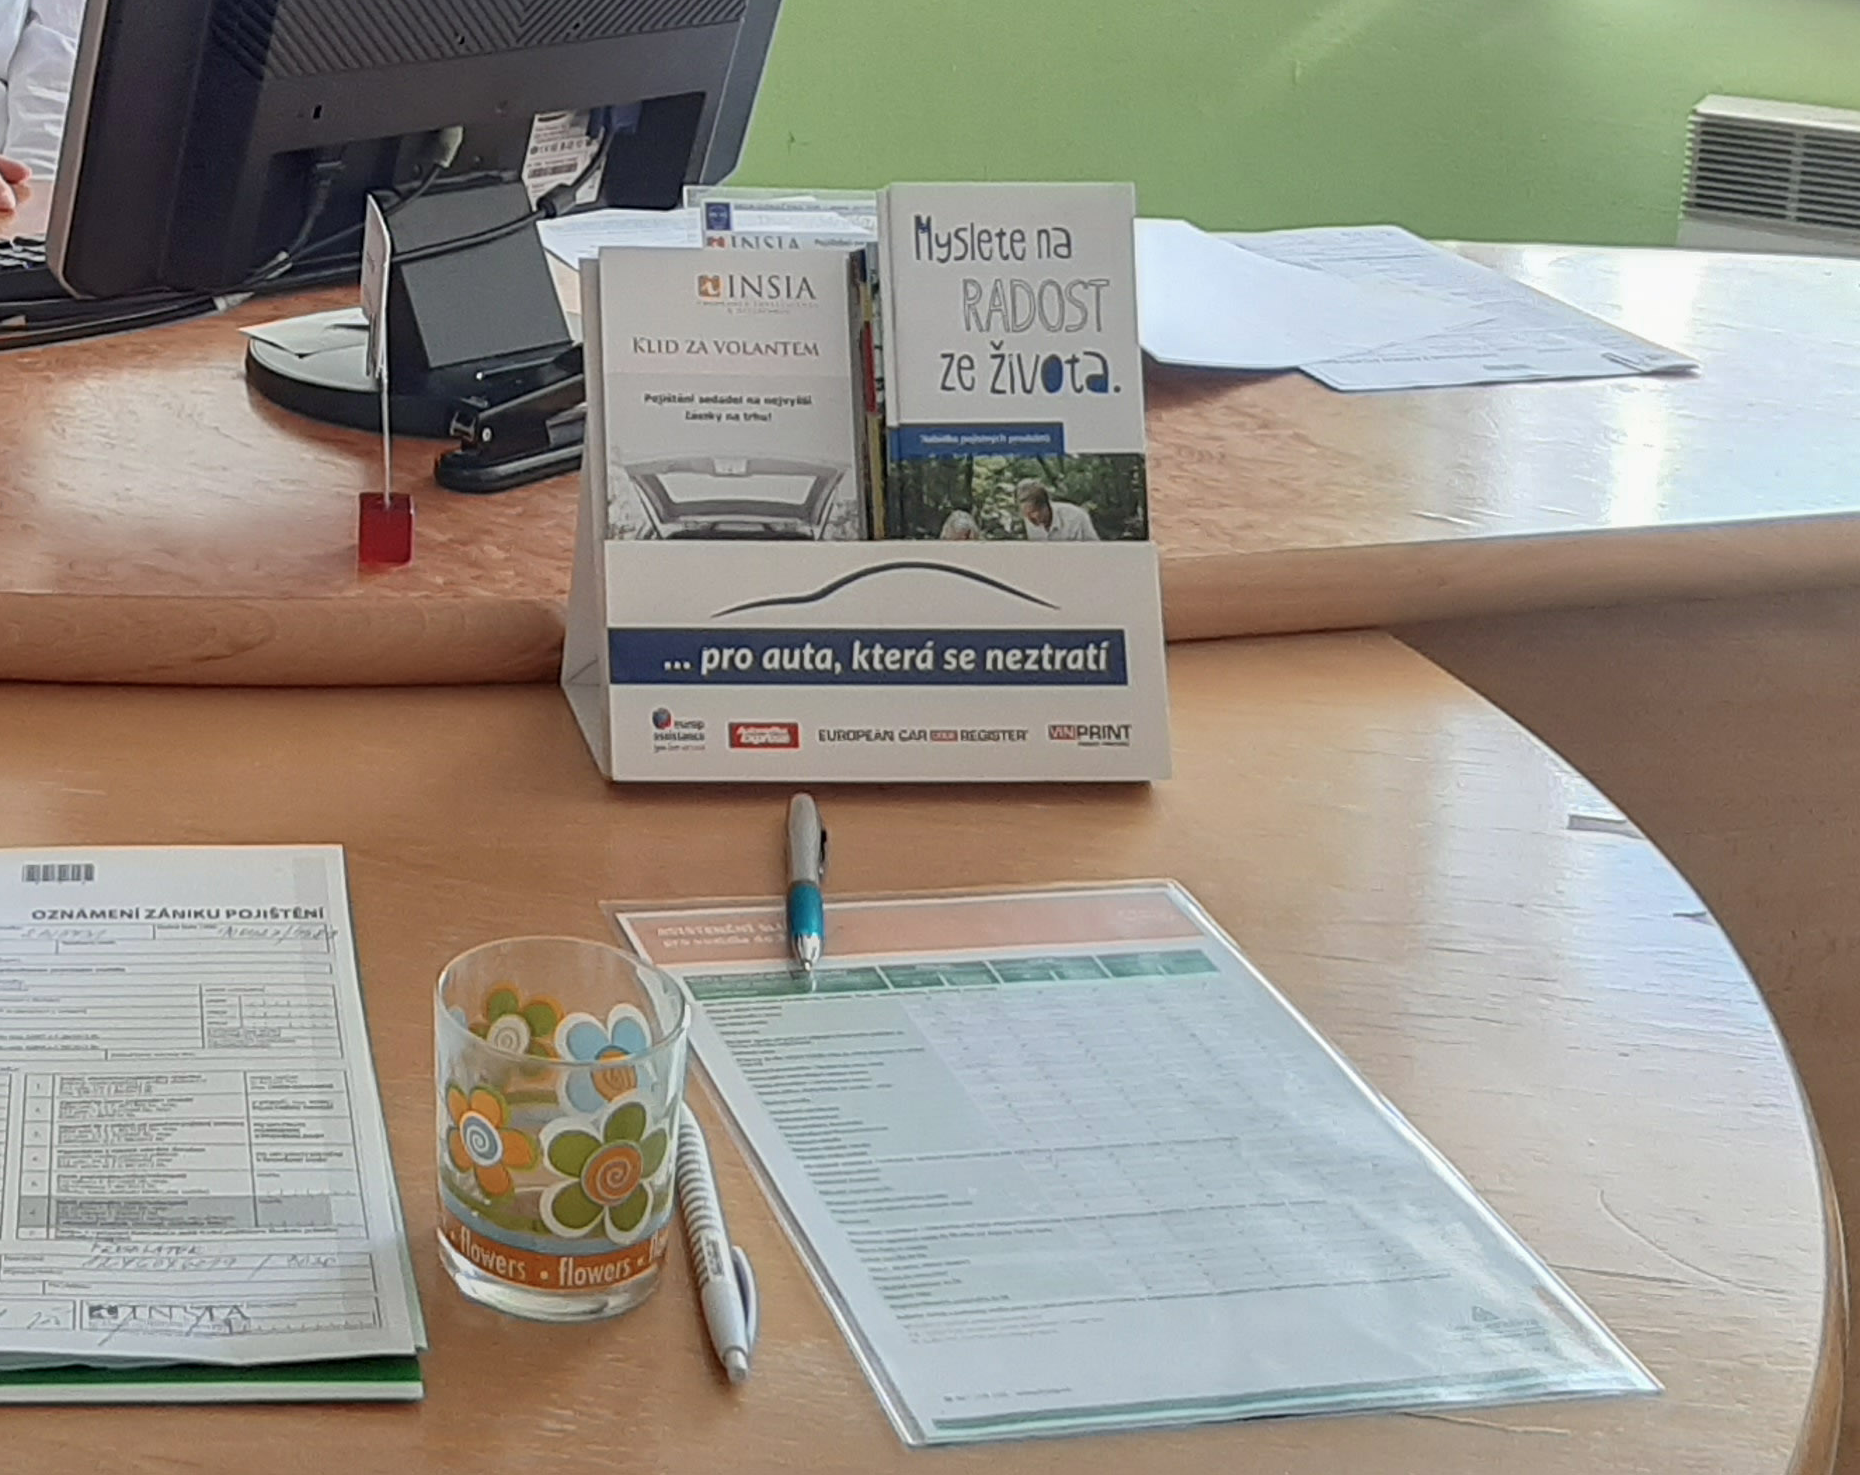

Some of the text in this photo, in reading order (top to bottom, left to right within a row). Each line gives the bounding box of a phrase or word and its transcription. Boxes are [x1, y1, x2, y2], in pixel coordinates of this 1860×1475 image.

[914, 214, 1072, 263] Myslete na
[728, 275, 816, 299] INSIA
[962, 279, 1110, 333] RADOST
[633, 337, 819, 356] KLID ZA VOLANTEM
[940, 340, 1122, 395] ze života.
[701, 648, 754, 674] pro
[763, 643, 842, 674] auta,
[852, 640, 933, 670] která
[944, 648, 975, 670] se
[986, 641, 1109, 671] neztratí
[818, 729, 894, 742] EUROPEAN
[899, 729, 927, 742] CAR
[960, 729, 1028, 742] REGISTER
[32, 905, 324, 920] OZNÁMENÍ ZÁNIKU POJIŠTĚNÍ
[460, 1225, 630, 1286] flowers flowers
